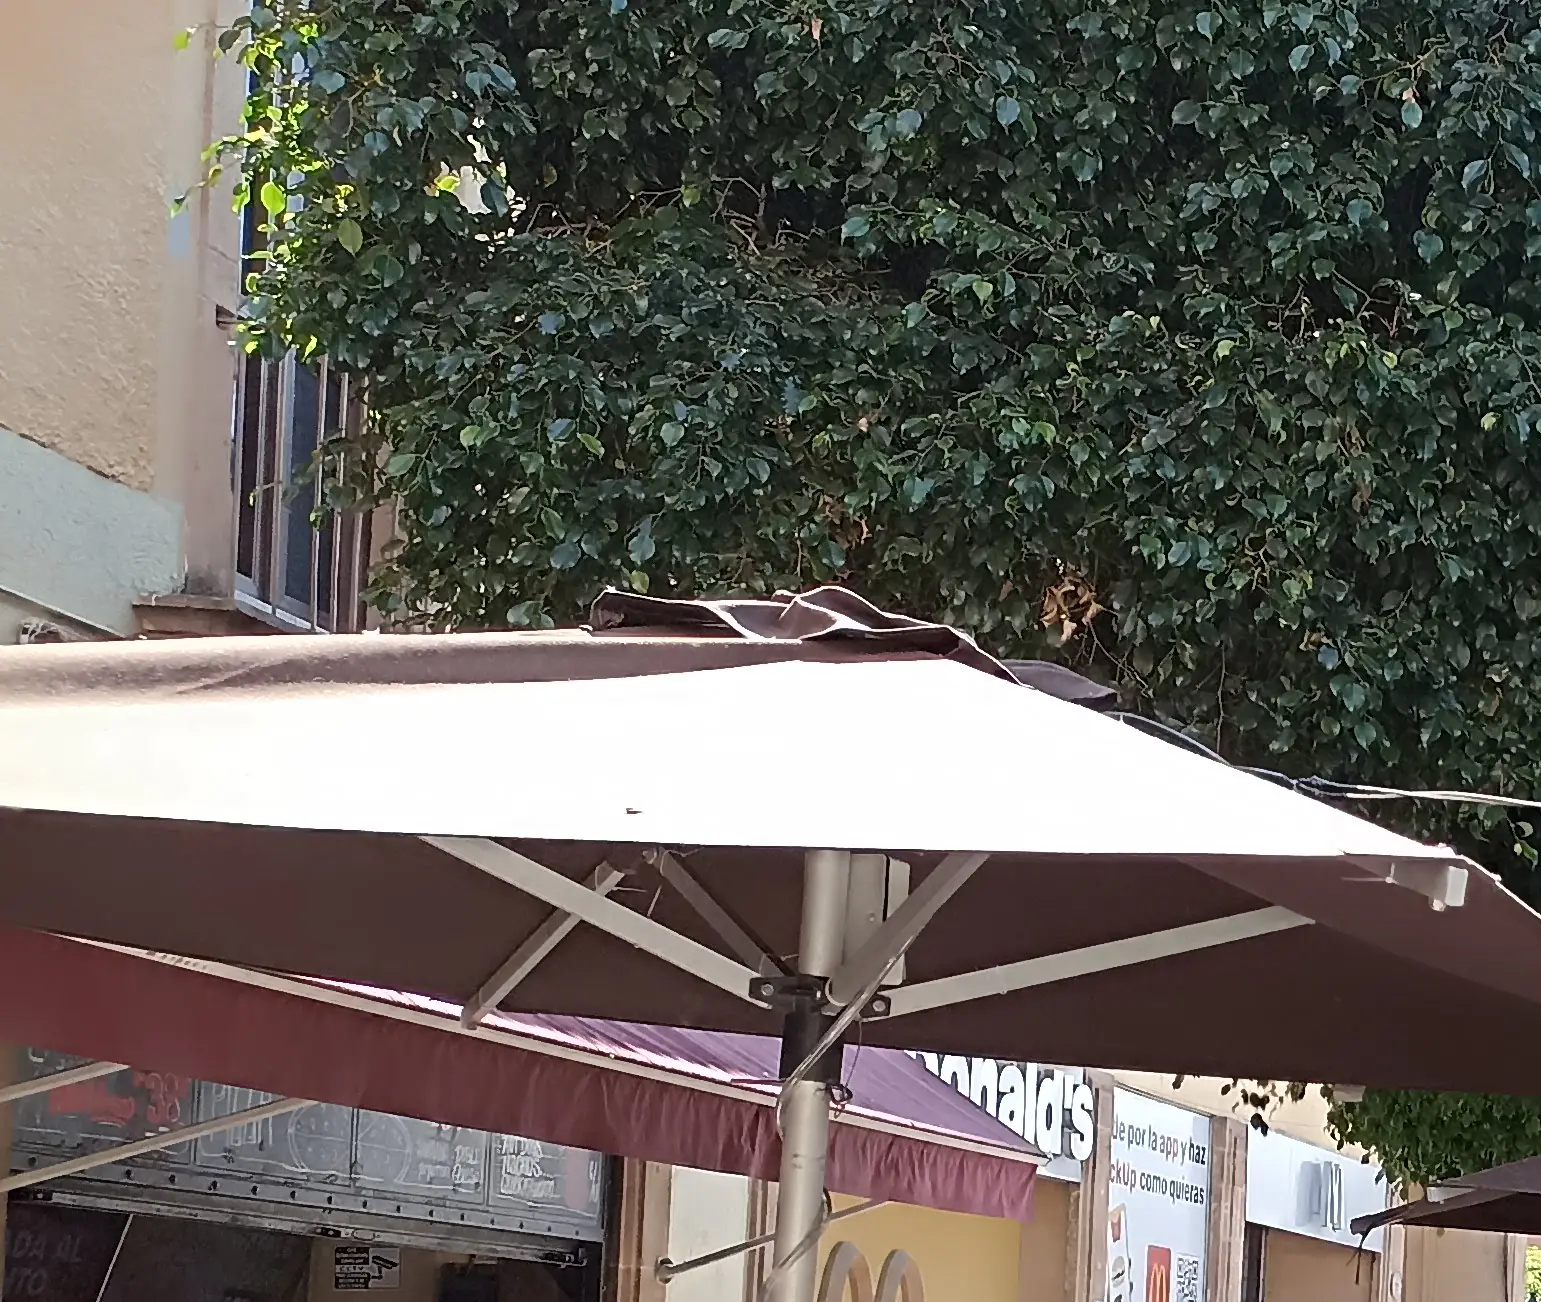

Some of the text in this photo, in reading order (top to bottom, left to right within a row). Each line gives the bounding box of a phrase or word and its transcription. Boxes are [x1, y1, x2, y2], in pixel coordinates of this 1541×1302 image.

[1127, 1124, 1146, 1151] por
[1148, 1124, 1158, 1151] la
[1159, 1134, 1179, 1163] app
[1180, 1140, 1188, 1167] y
[1188, 1136, 1206, 1166] haz
[1139, 1171, 1168, 1195] como
[1169, 1175, 1205, 1205] quieras
